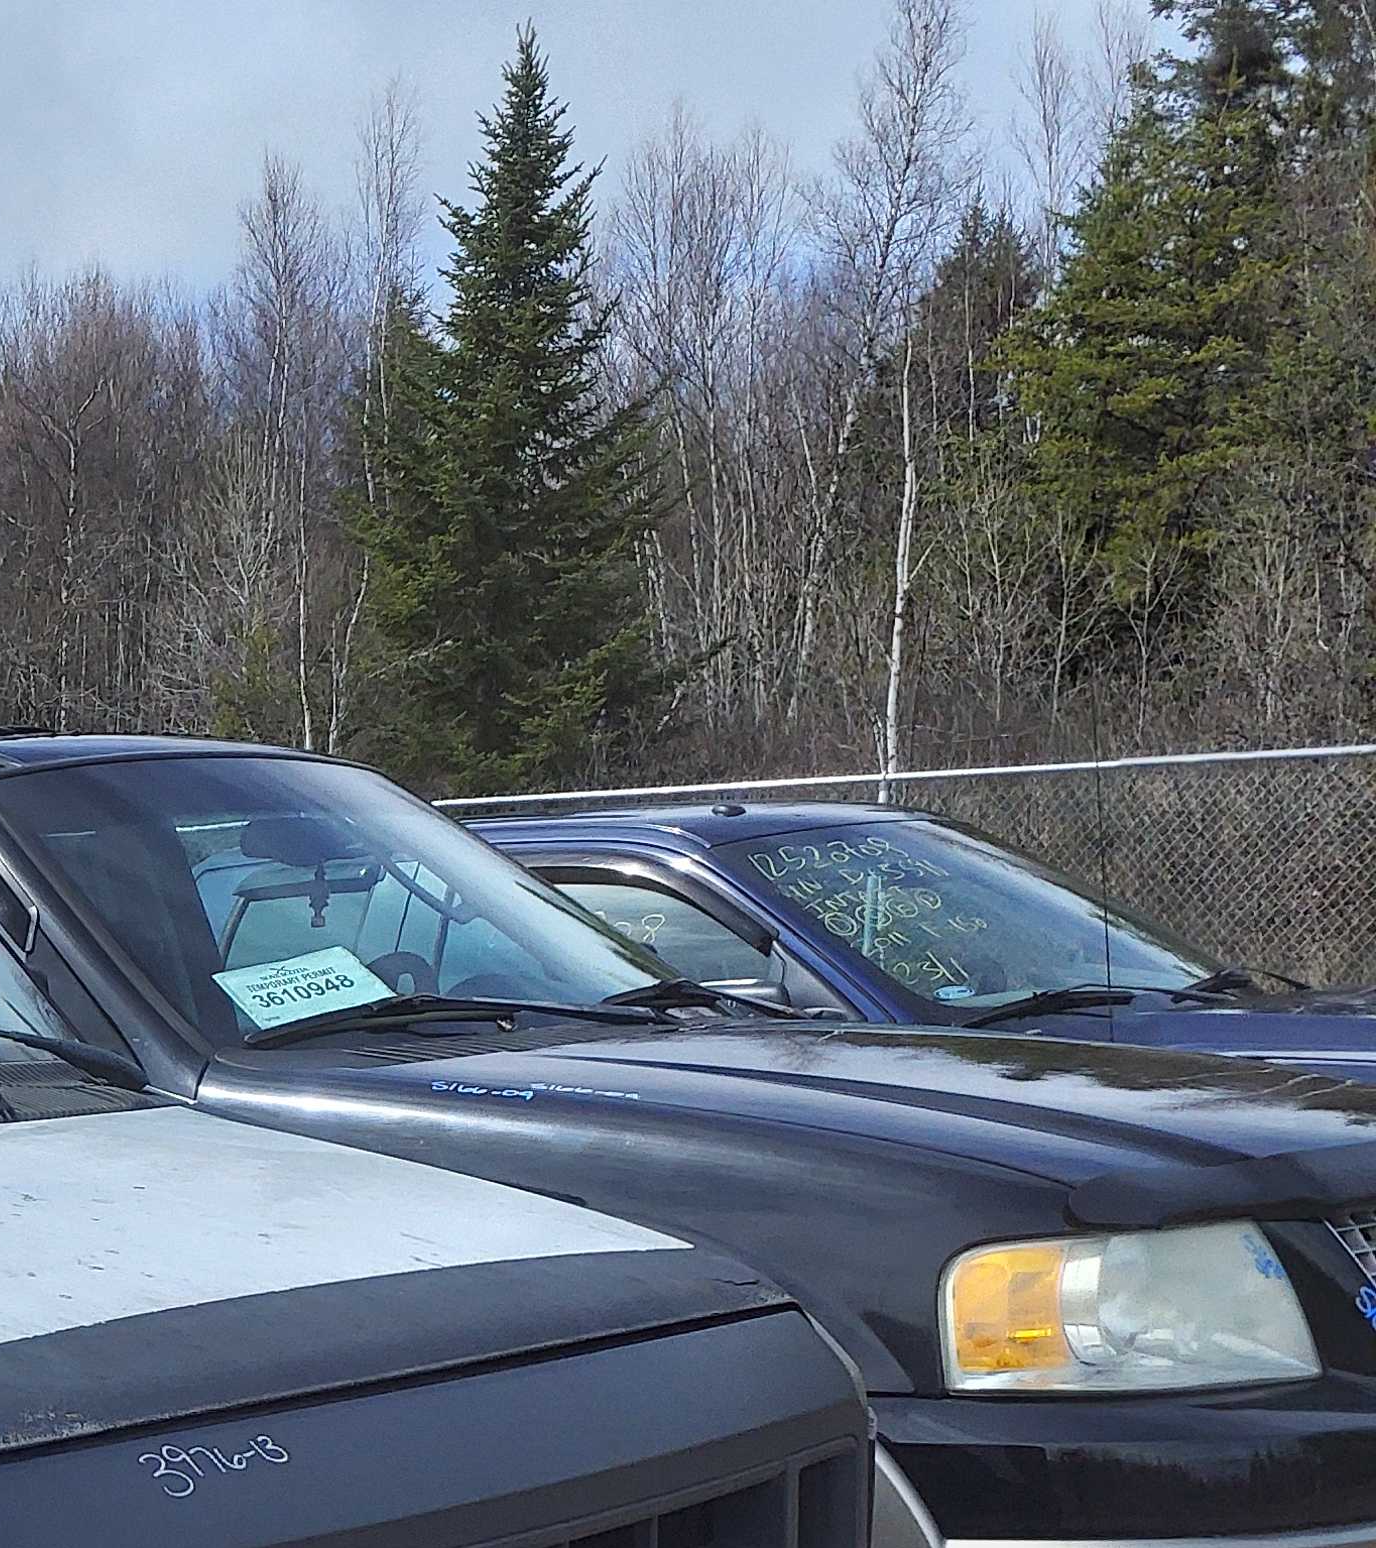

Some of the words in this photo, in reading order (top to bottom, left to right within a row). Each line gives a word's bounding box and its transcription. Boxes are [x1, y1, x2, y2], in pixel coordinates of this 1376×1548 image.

[246, 976, 301, 993] TEMPORARY
[301, 966, 336, 983] PERMIT
[252, 974, 355, 1008] 3610948
